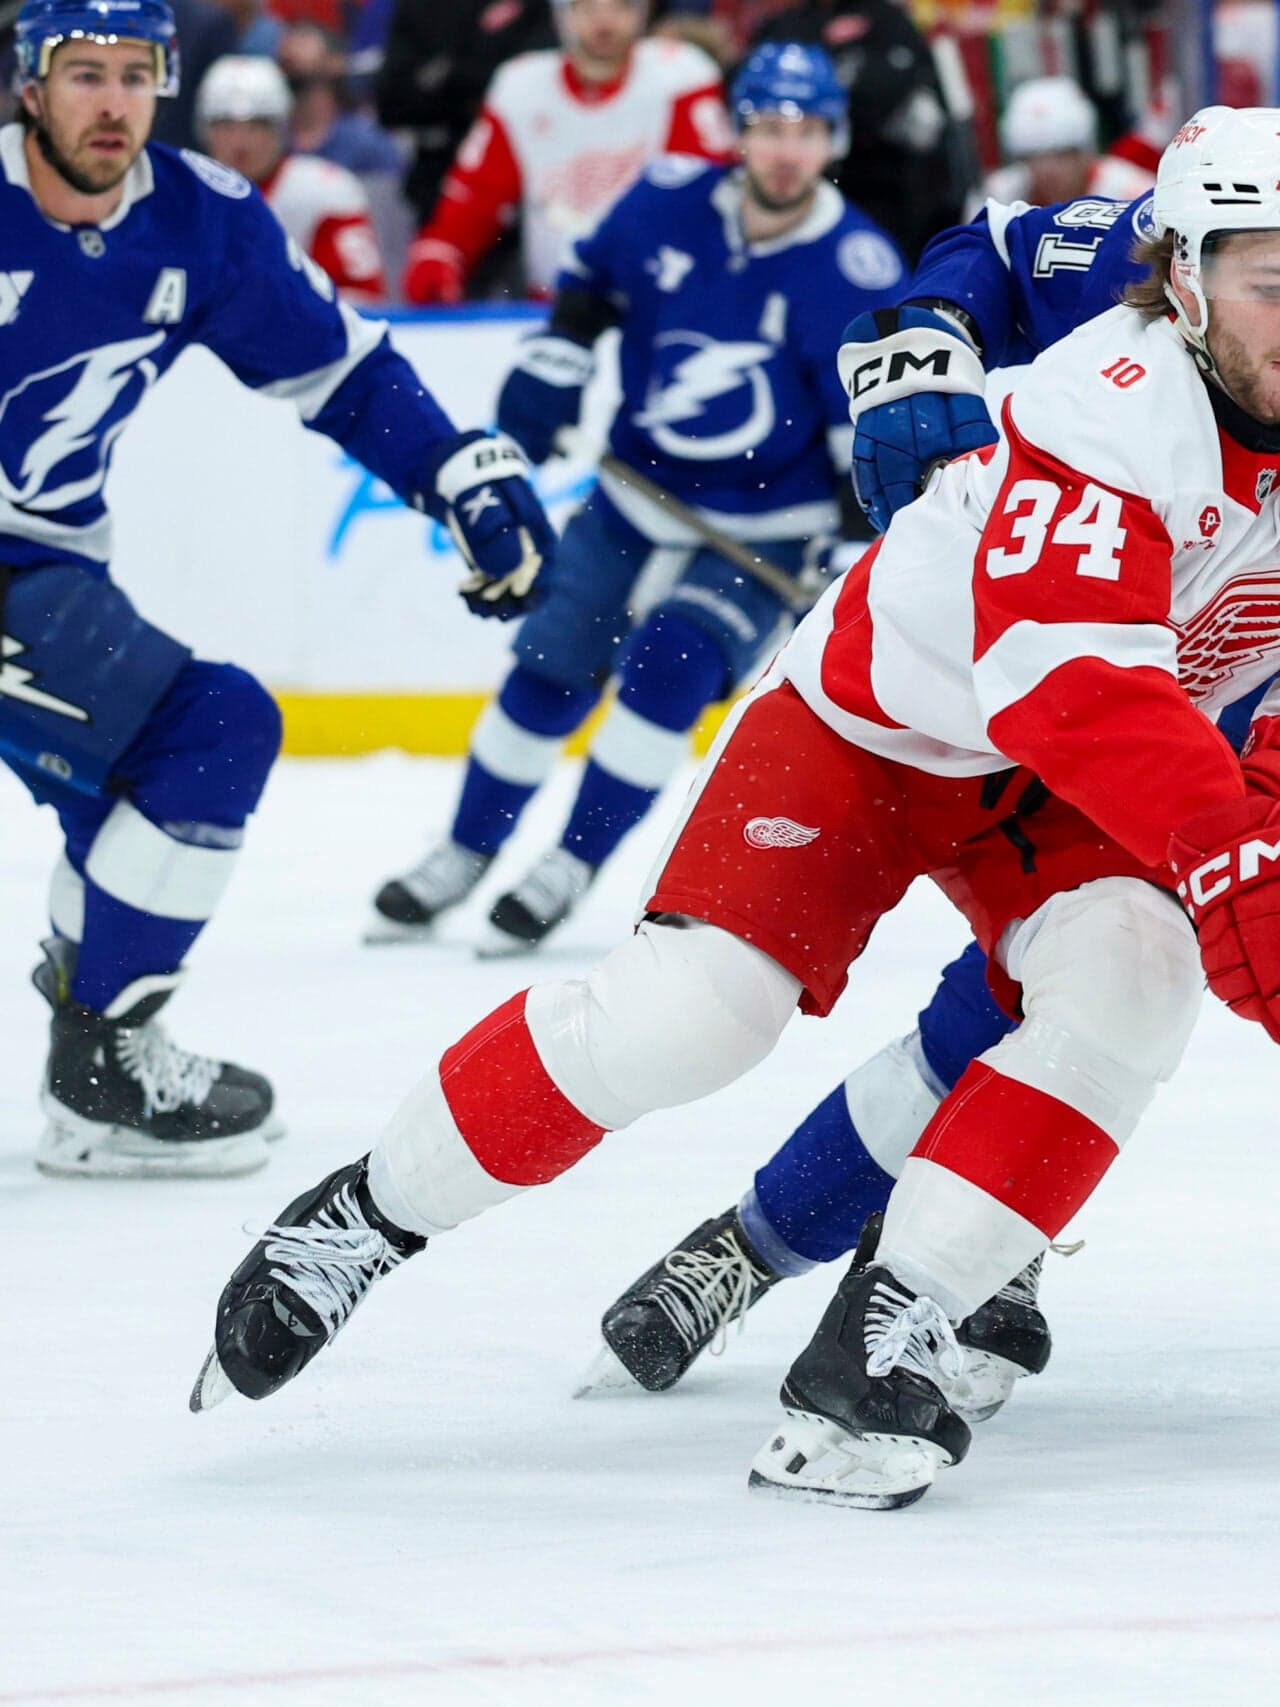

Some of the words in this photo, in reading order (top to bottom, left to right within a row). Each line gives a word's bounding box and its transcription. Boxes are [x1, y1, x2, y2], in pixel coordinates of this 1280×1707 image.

[142, 268, 188, 325] A
[848, 349, 952, 400] CM
[1101, 357, 1147, 389] 10
[985, 478, 1128, 581] 34
